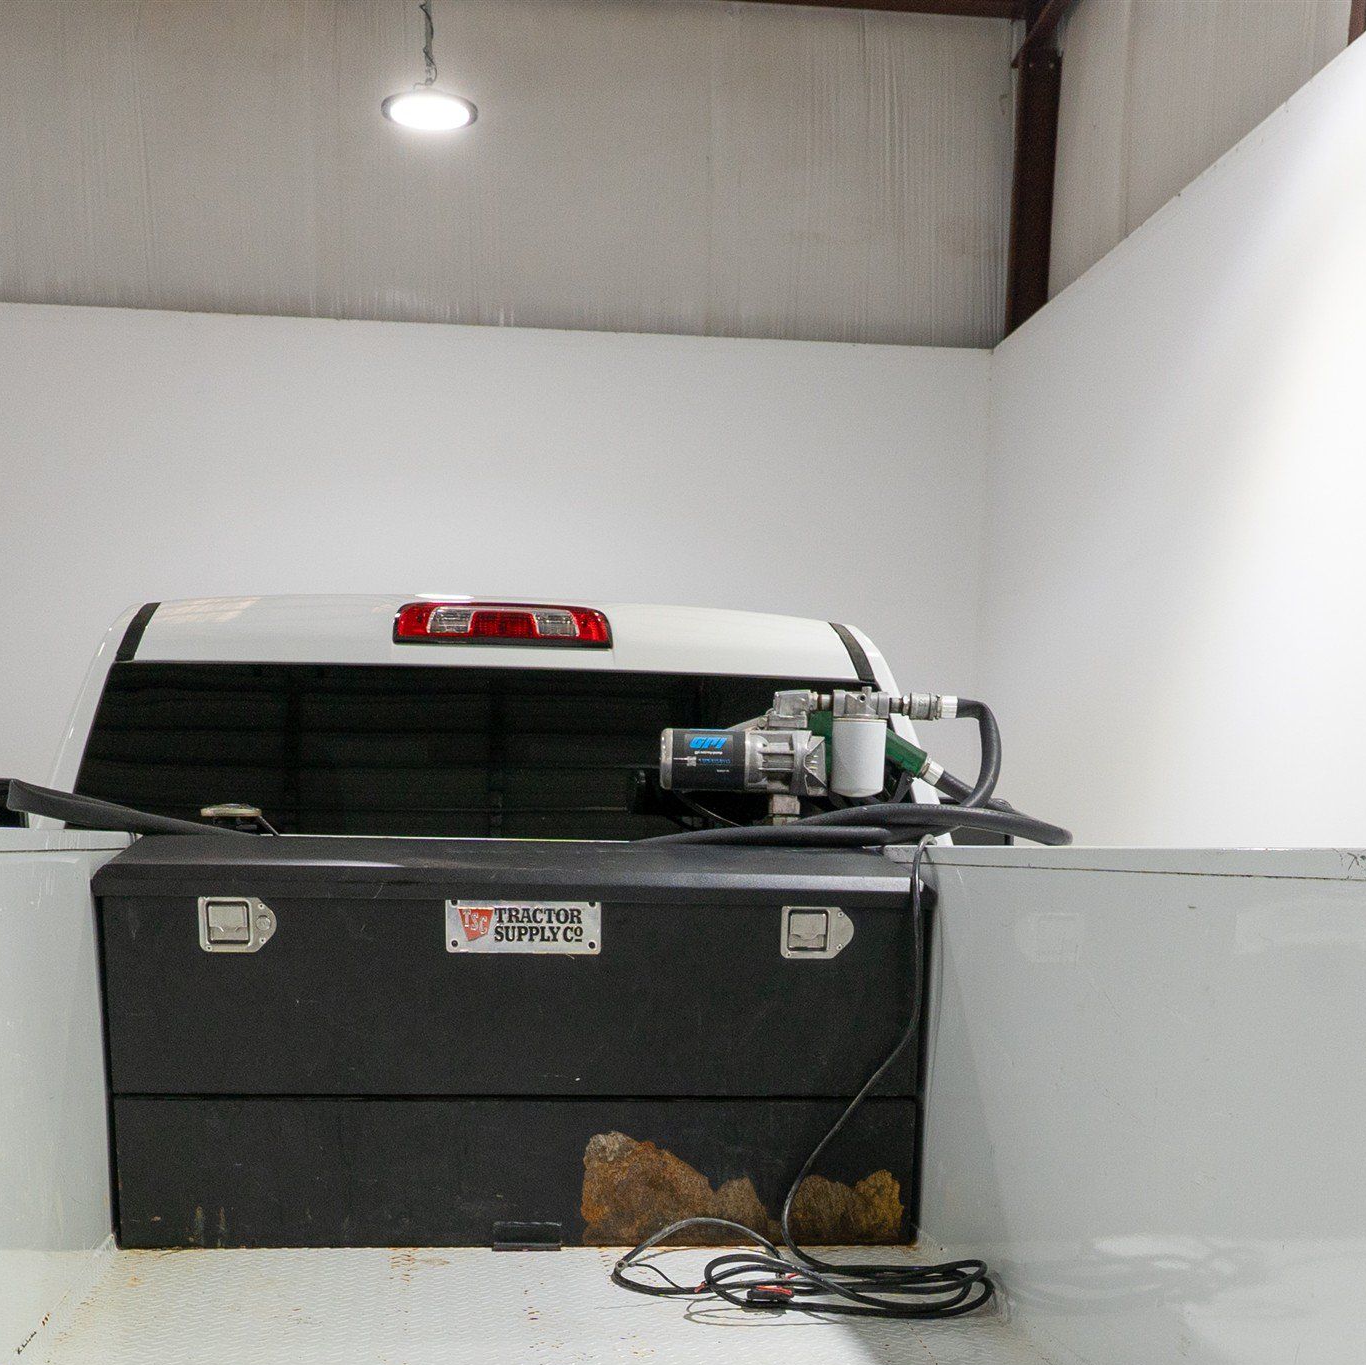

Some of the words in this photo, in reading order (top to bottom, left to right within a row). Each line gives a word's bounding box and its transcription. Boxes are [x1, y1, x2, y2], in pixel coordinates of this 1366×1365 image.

[689, 736, 727, 749] GPI
[462, 909, 487, 935] TSC
[494, 907, 583, 924] TRACTOR
[494, 925, 561, 943] SUPPLY
